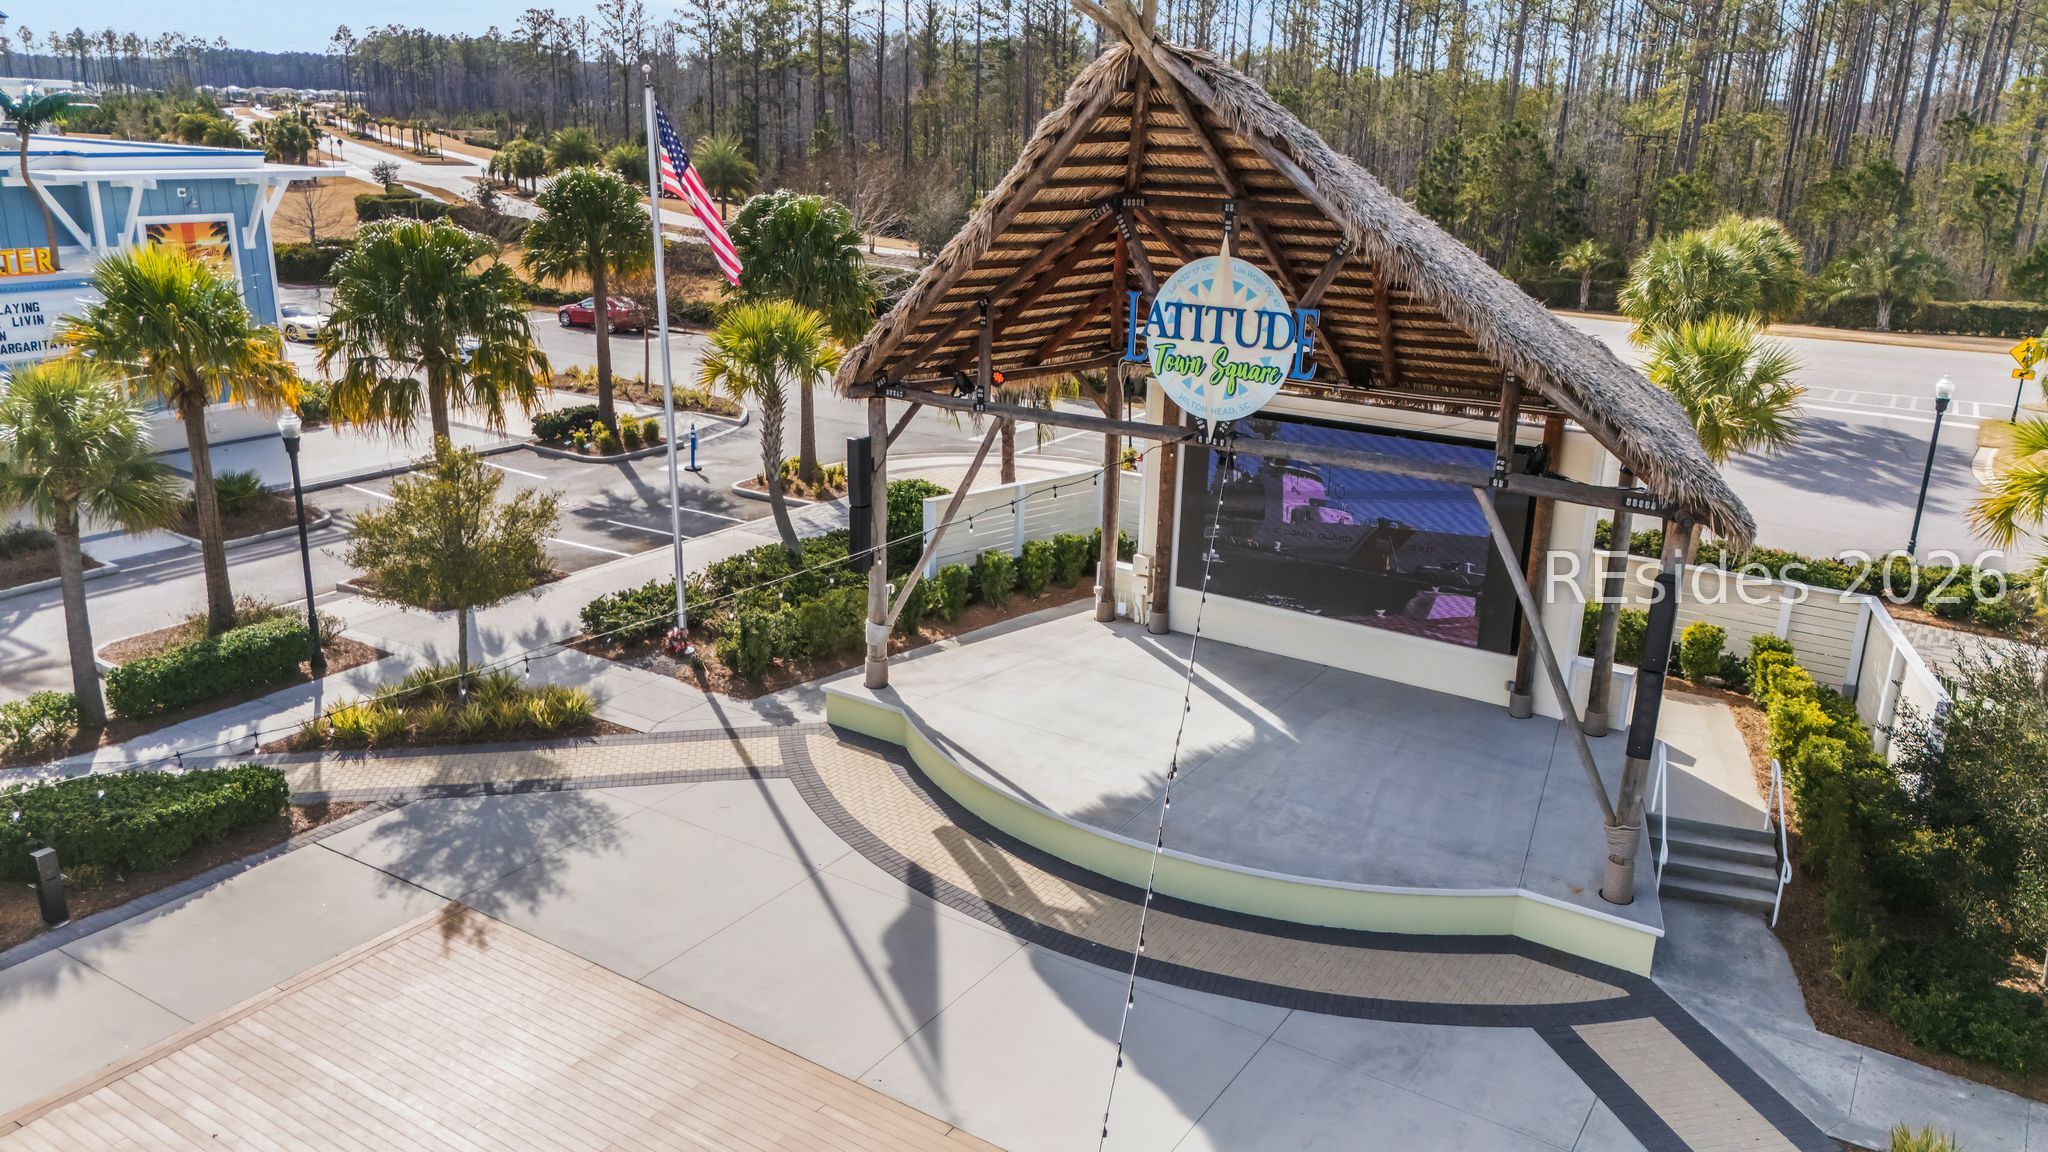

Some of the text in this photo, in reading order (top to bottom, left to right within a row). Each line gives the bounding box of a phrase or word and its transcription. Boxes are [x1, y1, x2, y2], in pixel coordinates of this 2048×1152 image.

[0, 247, 57, 275] TER
[11, 314, 45, 328] LIVIN
[1122, 290, 1320, 381] LATITUDE
[1154, 342, 1284, 396] Town Square
[1178, 393, 1208, 413] HILTON
[1239, 401, 1251, 412] SC
